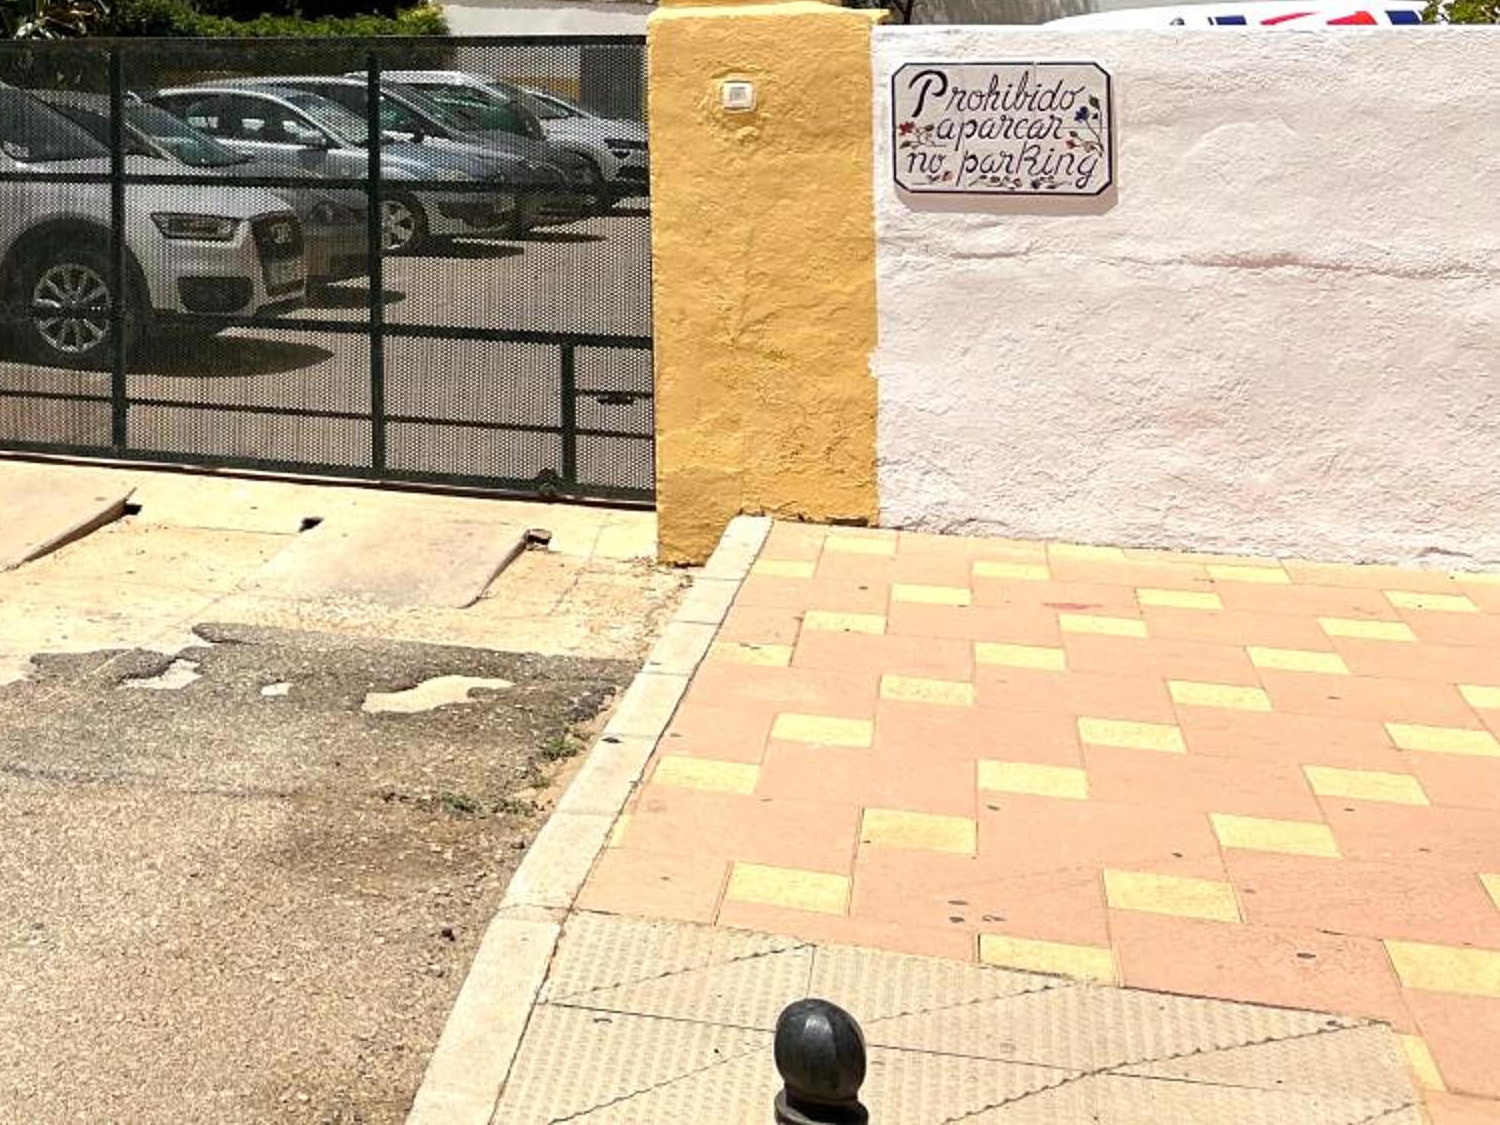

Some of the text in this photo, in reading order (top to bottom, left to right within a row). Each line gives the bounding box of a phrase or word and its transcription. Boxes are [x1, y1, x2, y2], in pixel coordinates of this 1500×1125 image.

[908, 69, 1086, 117] Prohibido
[936, 114, 1065, 151] aparcar
[907, 141, 1099, 189] no parking
